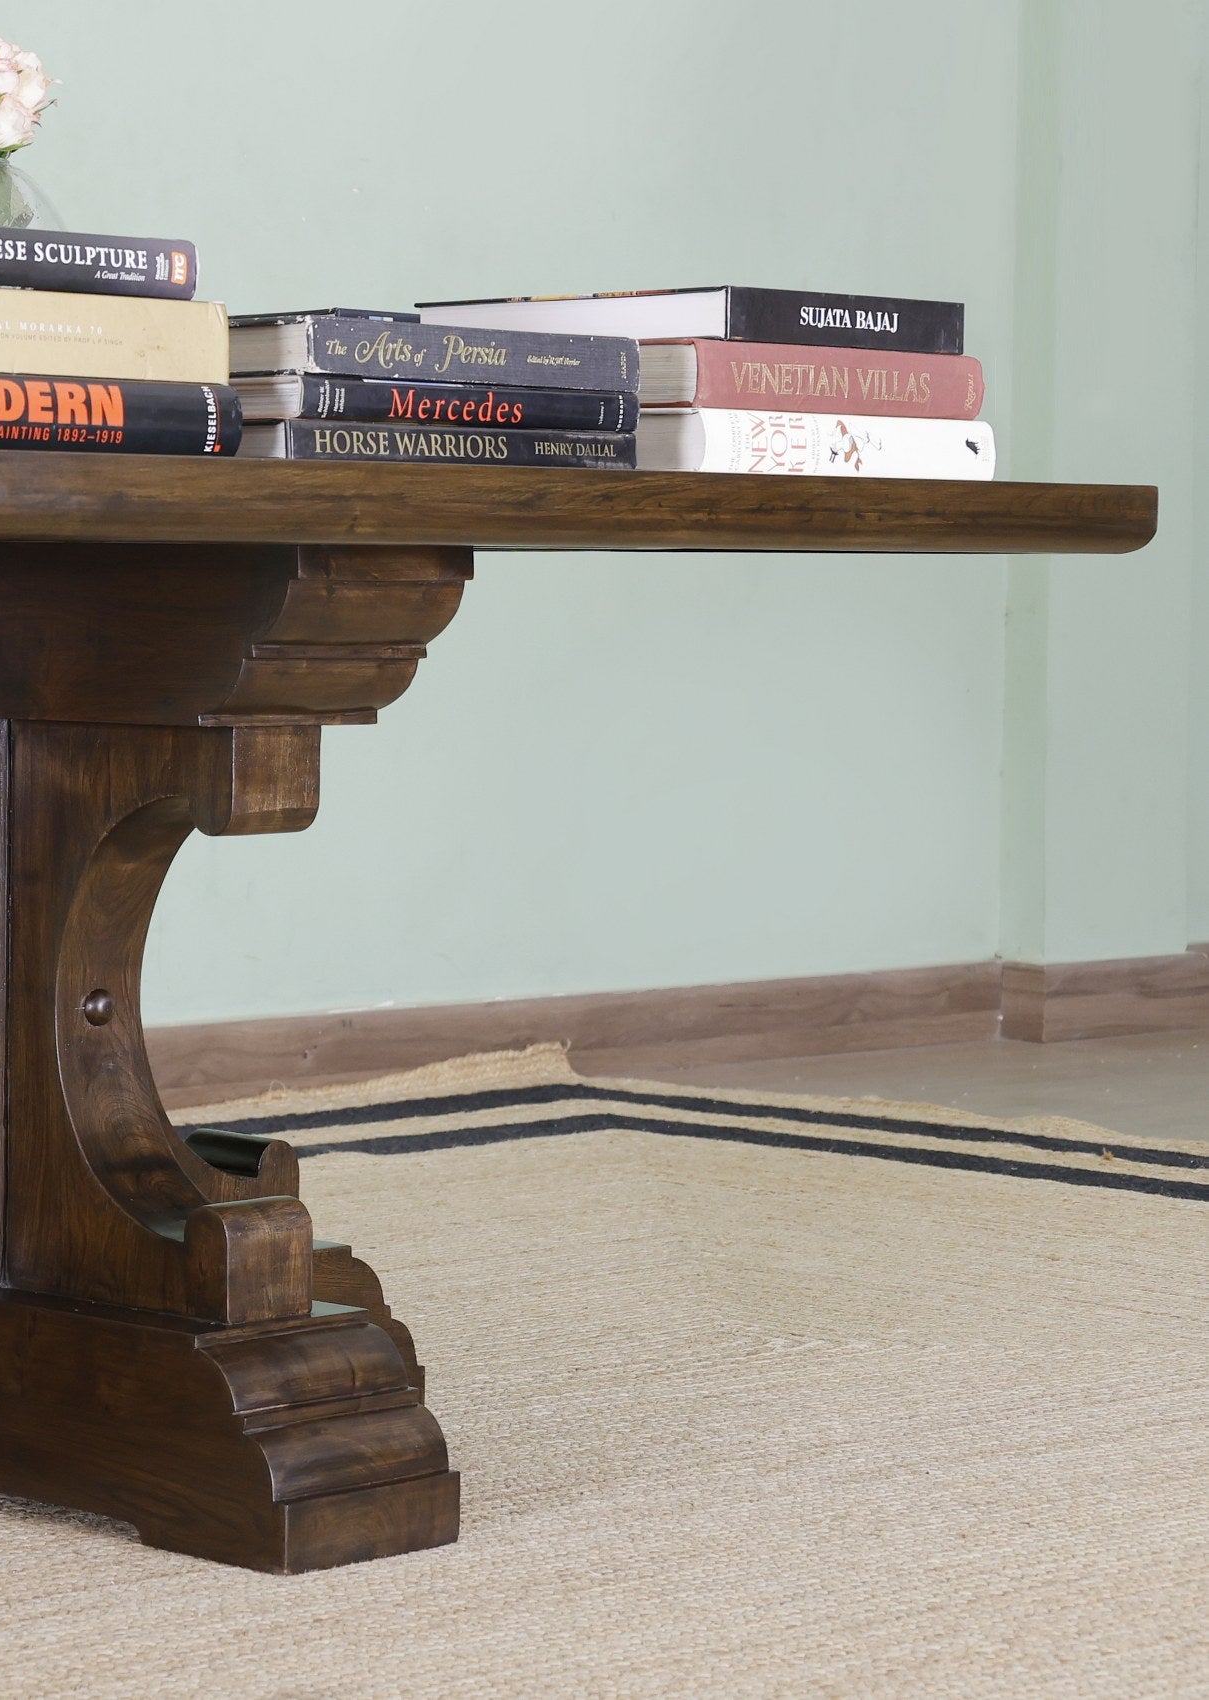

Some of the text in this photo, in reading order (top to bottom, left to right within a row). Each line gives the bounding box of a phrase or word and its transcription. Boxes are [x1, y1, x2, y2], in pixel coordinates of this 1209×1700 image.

[33, 241, 148, 270] SCULPTURE
[94, 270, 101, 279] A
[19, 321, 82, 334] MORARKA
[799, 305, 900, 334] SUJATA BAJAJ
[325, 331, 508, 373] The Arts of Persia
[730, 361, 932, 404] VENETIAN VILLAS
[200, 385, 217, 453] KIESELBACH
[388, 388, 524, 424] Mercedes
[313, 429, 617, 459] HORSE WARRIORS HENRY DALLAL
[746, 412, 768, 473] NEW
